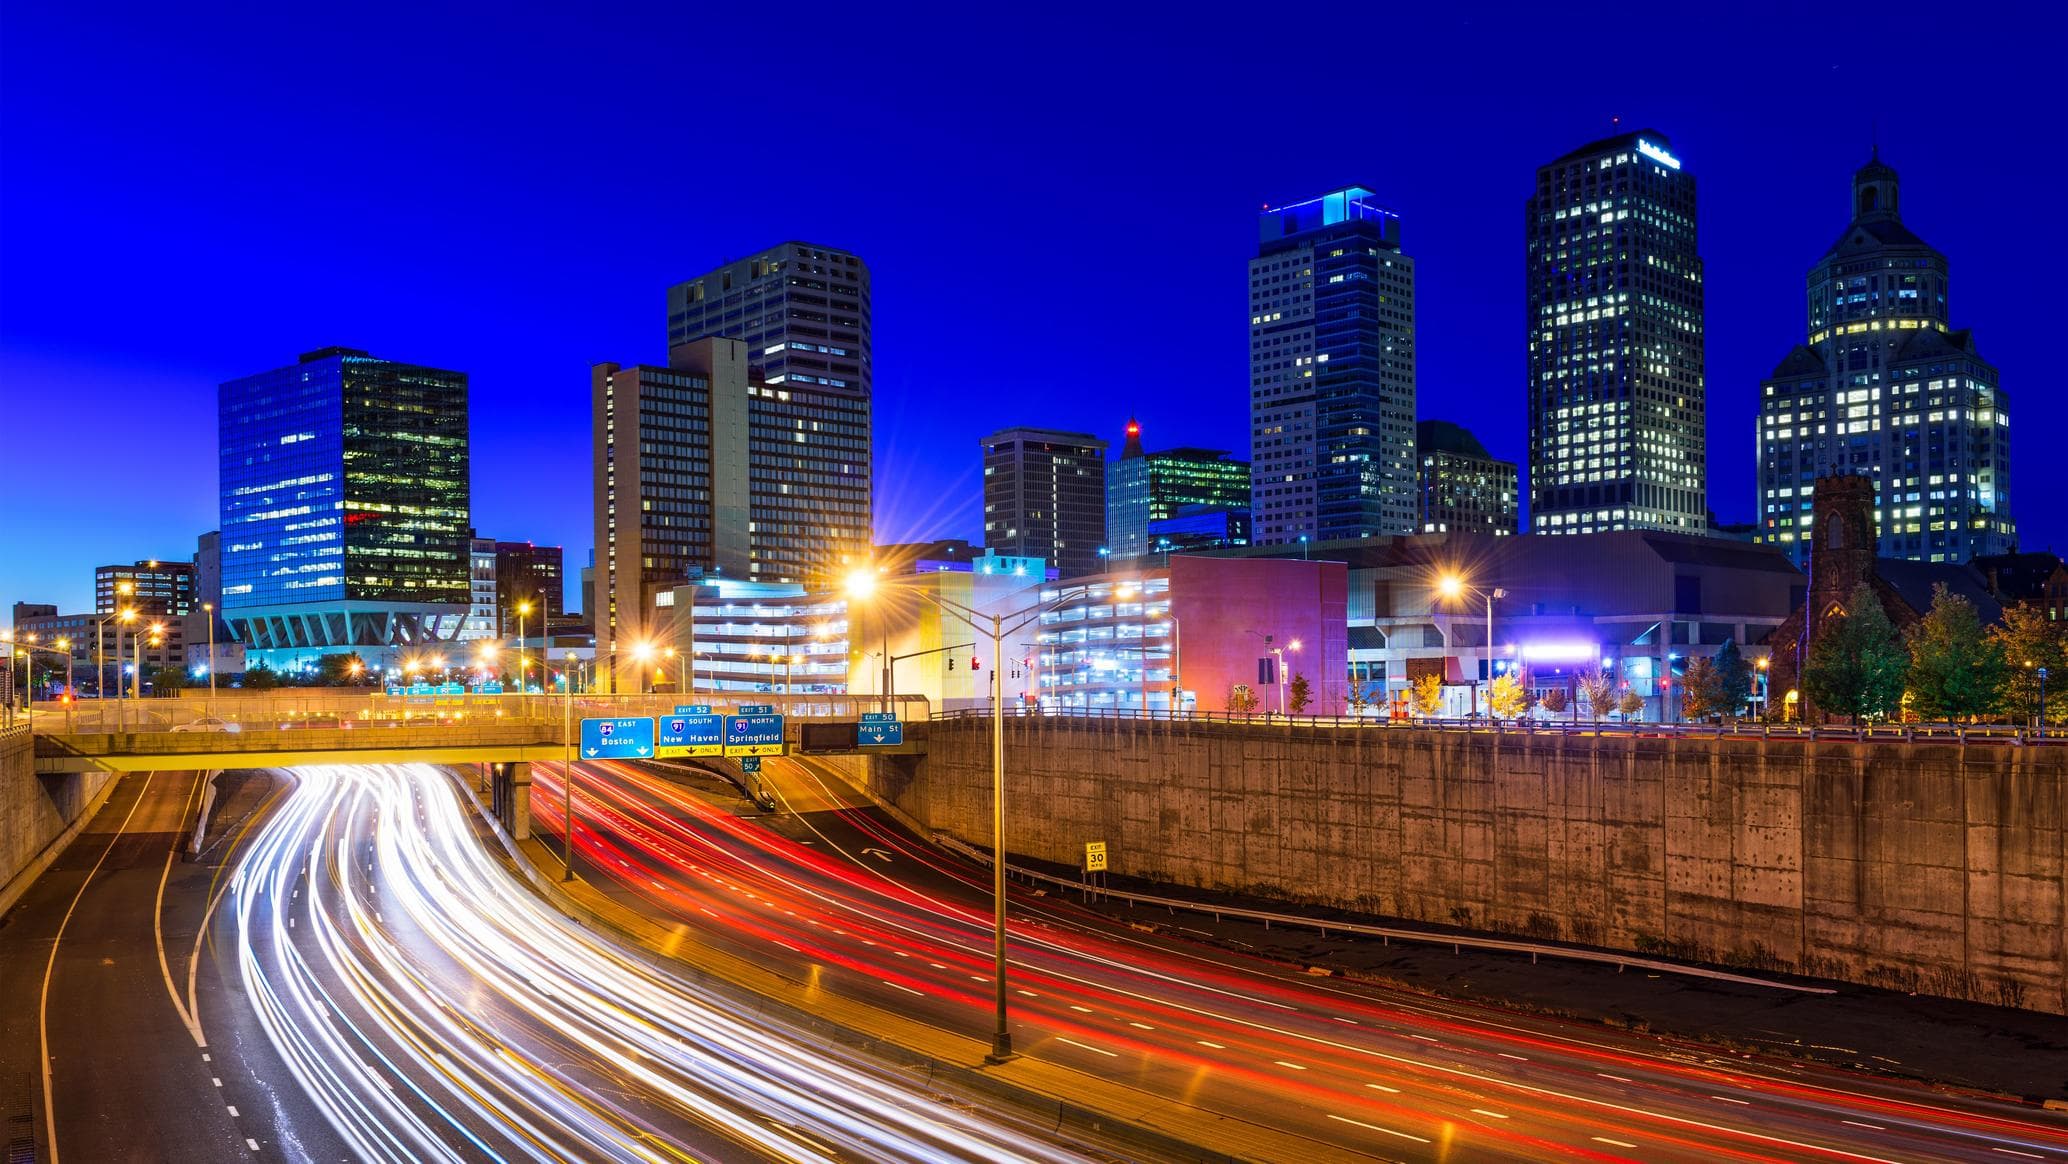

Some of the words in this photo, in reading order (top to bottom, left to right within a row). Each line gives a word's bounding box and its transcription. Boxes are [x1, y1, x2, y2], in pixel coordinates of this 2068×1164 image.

[601, 738, 634, 746] Boston
[663, 735, 683, 743] New
[690, 734, 719, 742] Haven
[729, 734, 779, 744] Springfield
[1091, 854, 1103, 862] 30
